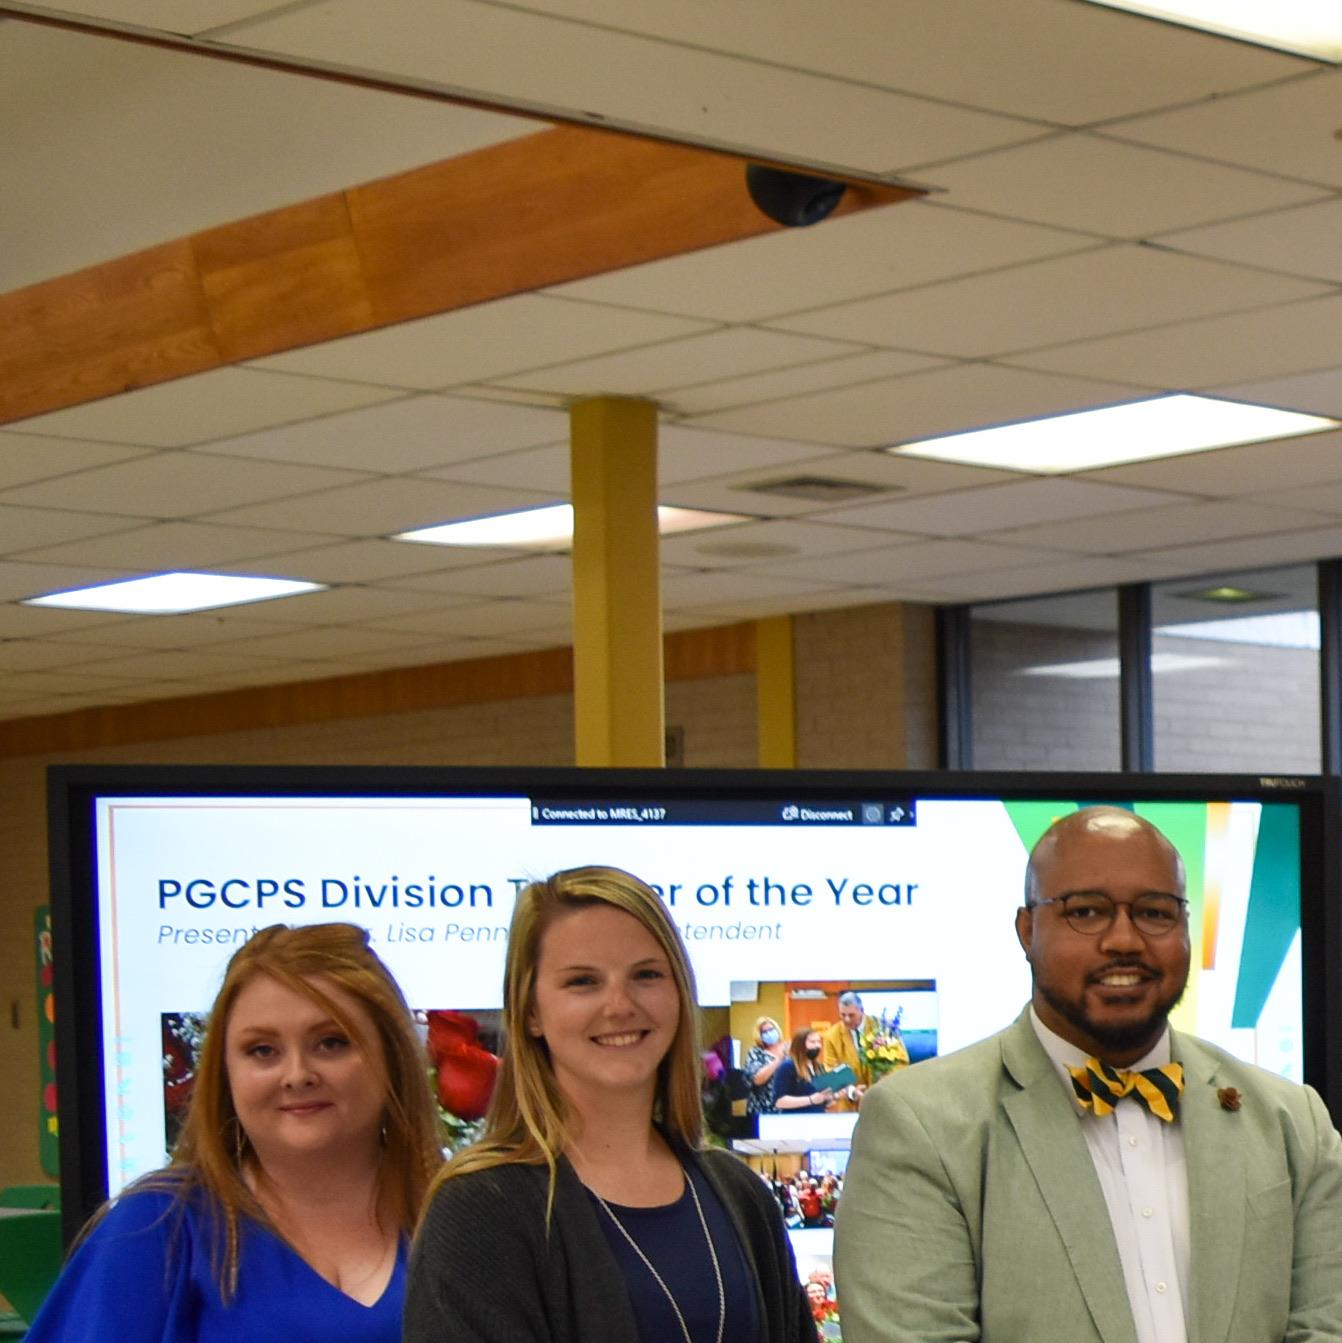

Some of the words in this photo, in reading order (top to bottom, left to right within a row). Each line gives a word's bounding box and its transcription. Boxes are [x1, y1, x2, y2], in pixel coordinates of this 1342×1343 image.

[541, 807, 596, 820] Connected
[597, 808, 609, 820] to
[800, 808, 853, 821] Disconnect
[158, 878, 306, 909] PGCPS
[321, 875, 493, 908] Division
[696, 875, 734, 906] of
[746, 877, 813, 906] the
[826, 878, 918, 906] Year
[158, 924, 294, 944] Present
[387, 923, 435, 942] Lisa
